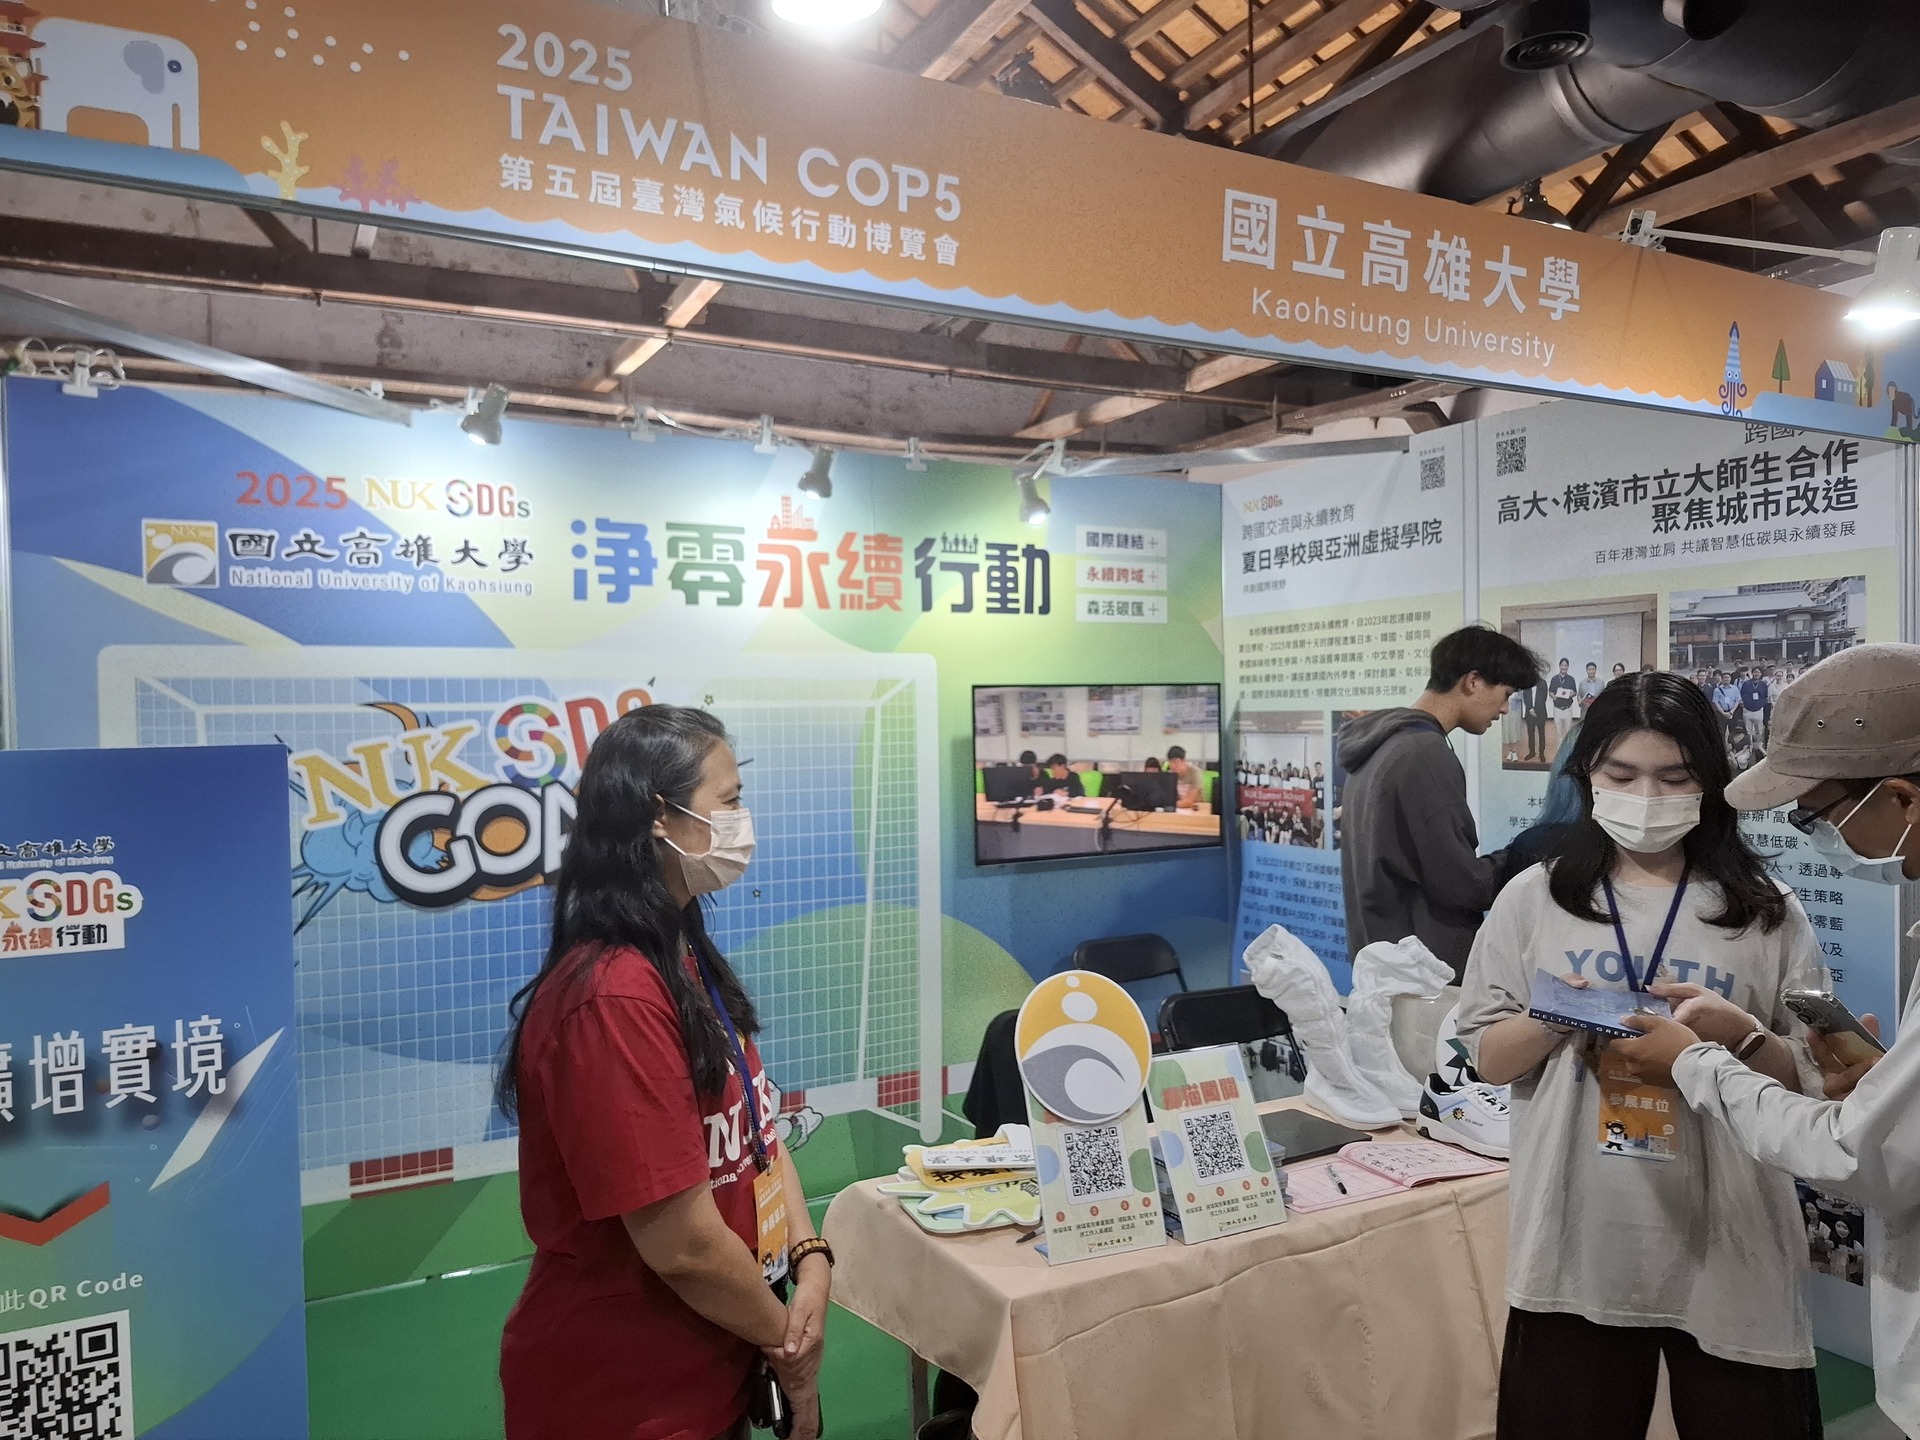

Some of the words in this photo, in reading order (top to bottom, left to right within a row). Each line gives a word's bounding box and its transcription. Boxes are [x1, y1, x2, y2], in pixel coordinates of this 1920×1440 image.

[496, 23, 633, 92] 2025
[496, 84, 768, 186] TAIWAN
[797, 147, 962, 222] COP5
[498, 154, 961, 267] 第五屆臺灣氣候行動博覽會
[1221, 188, 1582, 321] 國立高雄大學
[1251, 287, 1411, 345] Kaohsiung
[1424, 315, 1556, 367] University
[235, 471, 347, 510] 2025
[364, 477, 439, 512] NUK
[445, 479, 531, 518] SDGs
[1497, 439, 1860, 525] 高大、橫濱市立大師生合作
[1651, 475, 1860, 535] 聚焦城市改造
[1242, 504, 1356, 541] 跨國交流與永續教育
[1242, 518, 1443, 575] 夏日學校與亞洲虛擬學院
[1594, 540, 1676, 565] 百年港灣並肩
[1681, 520, 1857, 555] 共議智慧低碳與永續發展
[228, 531, 534, 573] 國立高雄大學
[232, 569, 310, 588] National
[320, 571, 412, 593] University
[419, 577, 439, 592] of
[446, 578, 534, 597] Kaohsiung
[294, 725, 493, 826] NUK
[26, 878, 134, 922] SDGs
[1791, 886, 1844, 906] 生策略
[2, 922, 108, 952] 永續行動
[1532, 1011, 1588, 1029] MELTING
[0, 1014, 227, 1122] 增實境
[76, 1272, 144, 1298] Code
